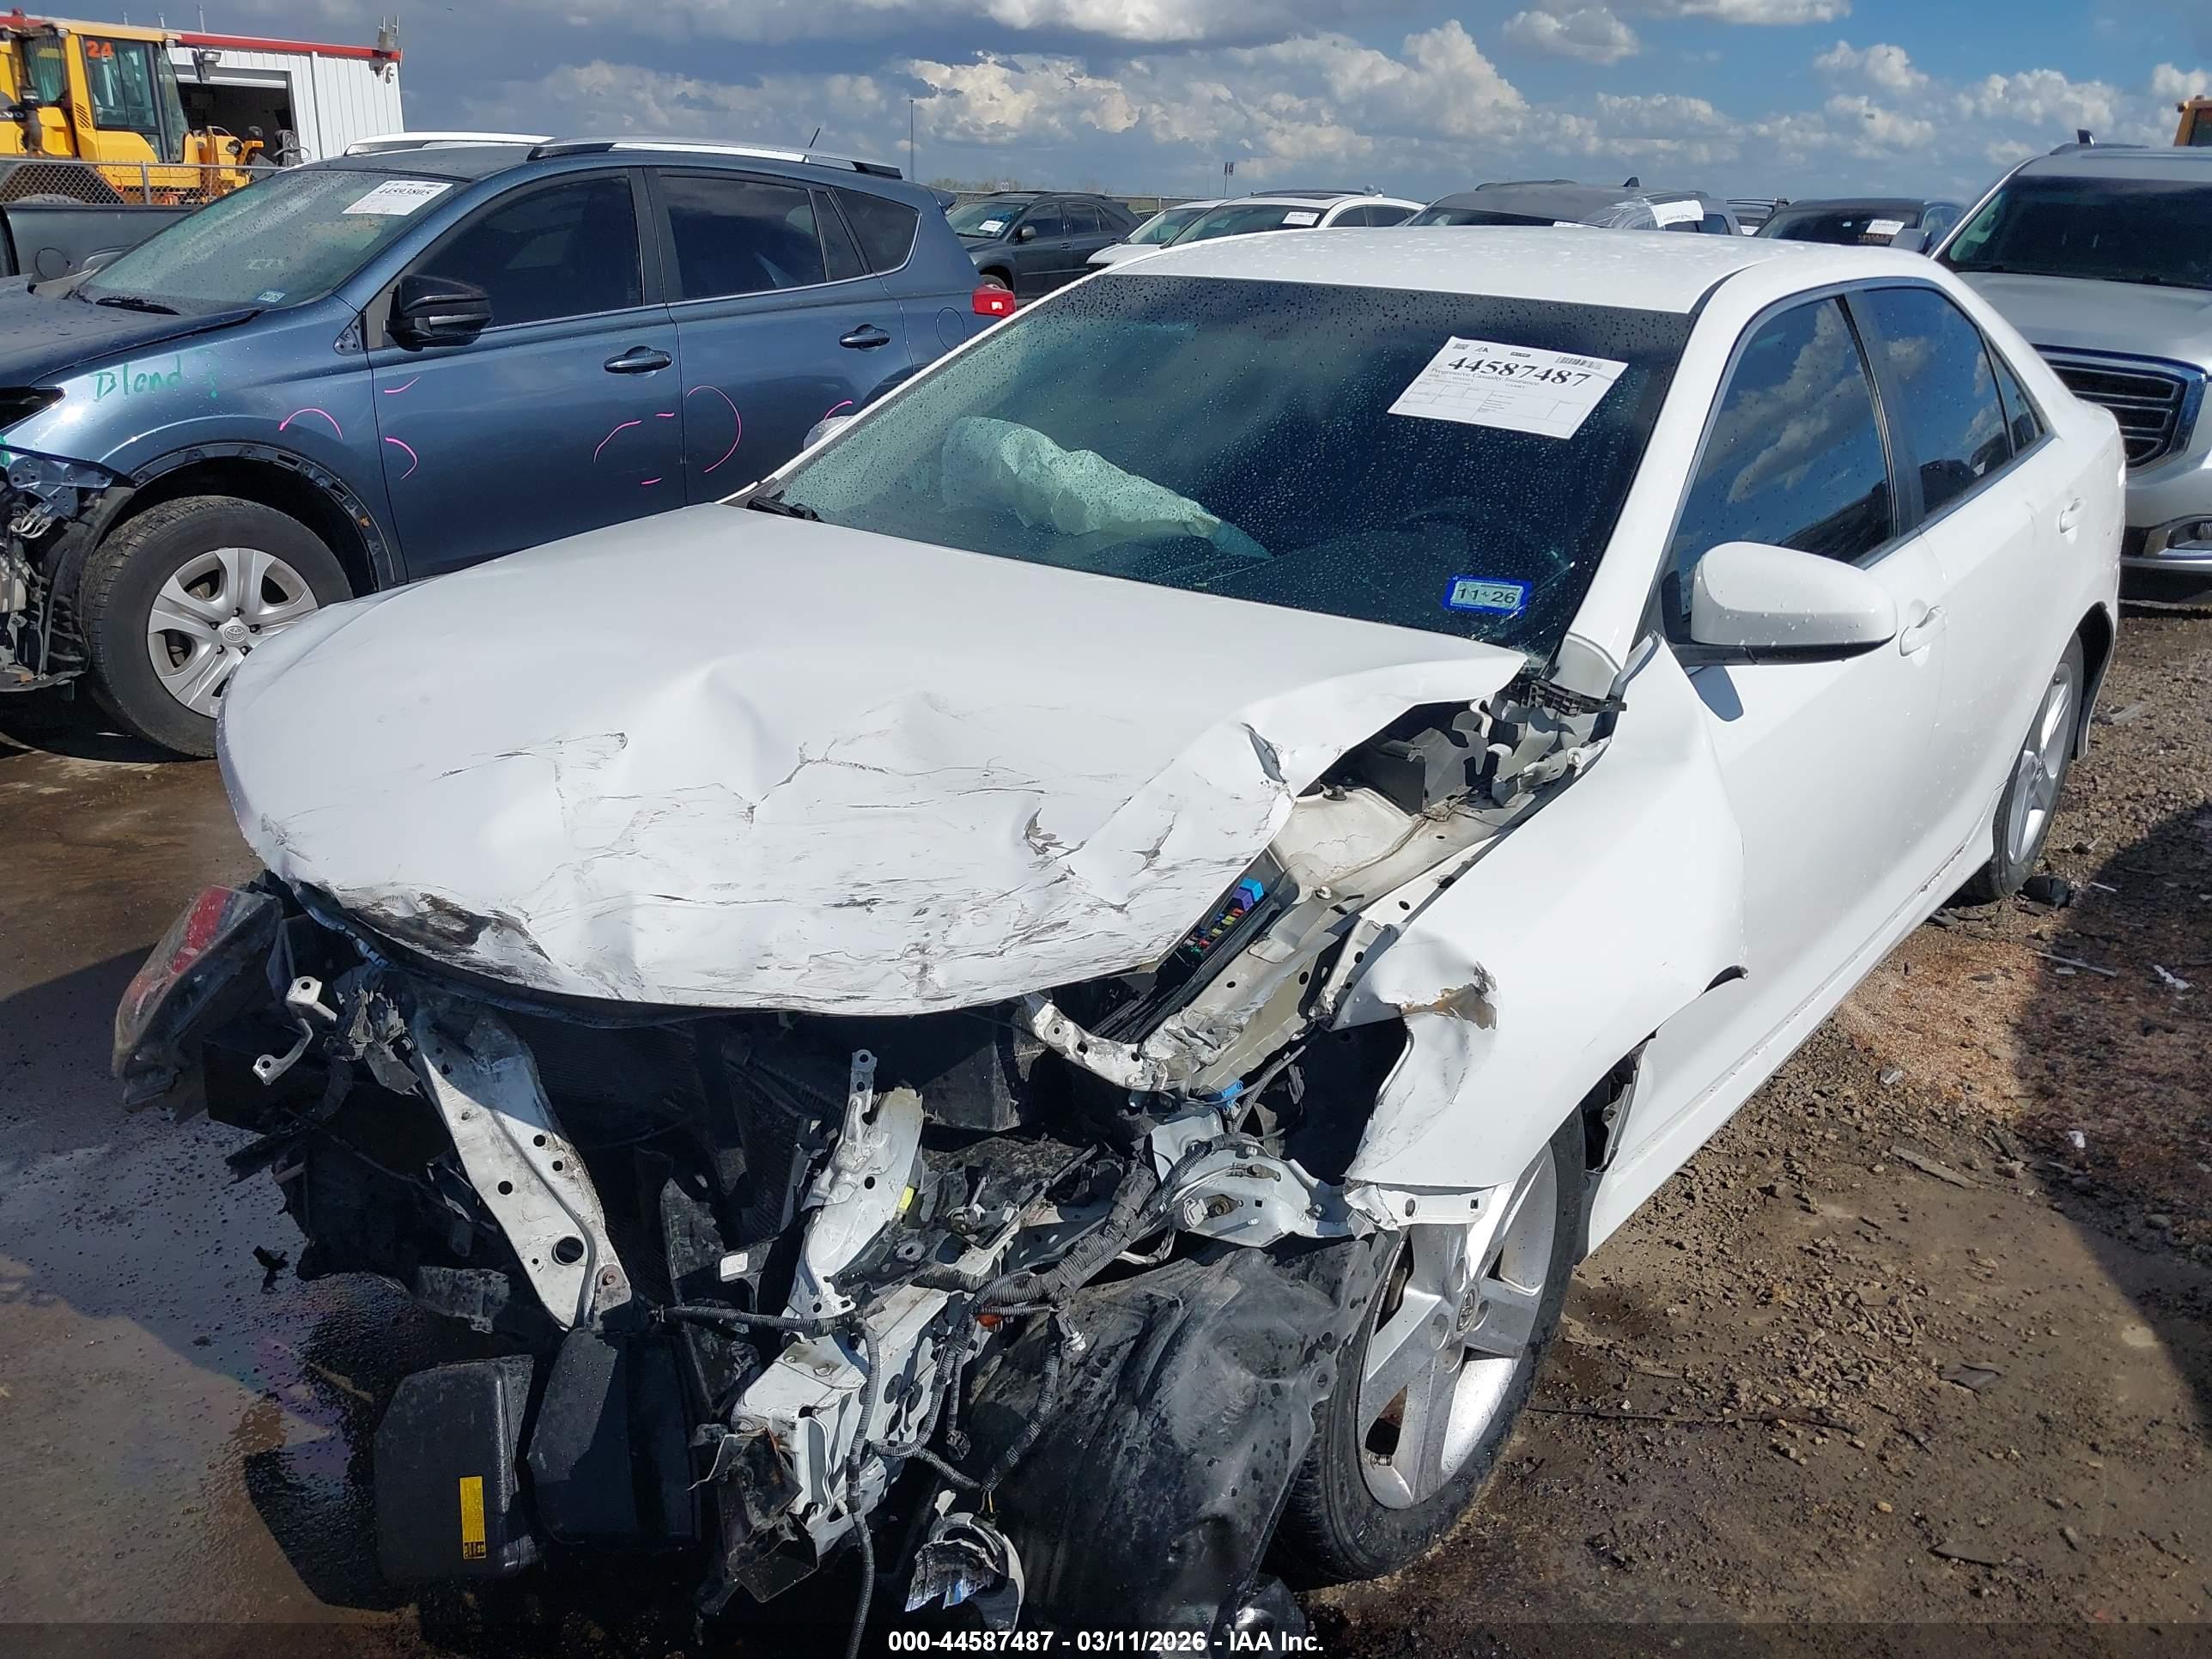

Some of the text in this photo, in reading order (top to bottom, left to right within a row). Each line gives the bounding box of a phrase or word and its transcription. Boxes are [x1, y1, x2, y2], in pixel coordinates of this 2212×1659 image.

[85, 40, 114, 58] 24
[90, 354, 184, 399] Blend
[1431, 368, 1471, 377] Progressive
[1472, 373, 1503, 382] Casualty
[1504, 377, 1540, 386] Insurance
[1448, 357, 1593, 386] 44587487
[1491, 591, 1517, 604] 26
